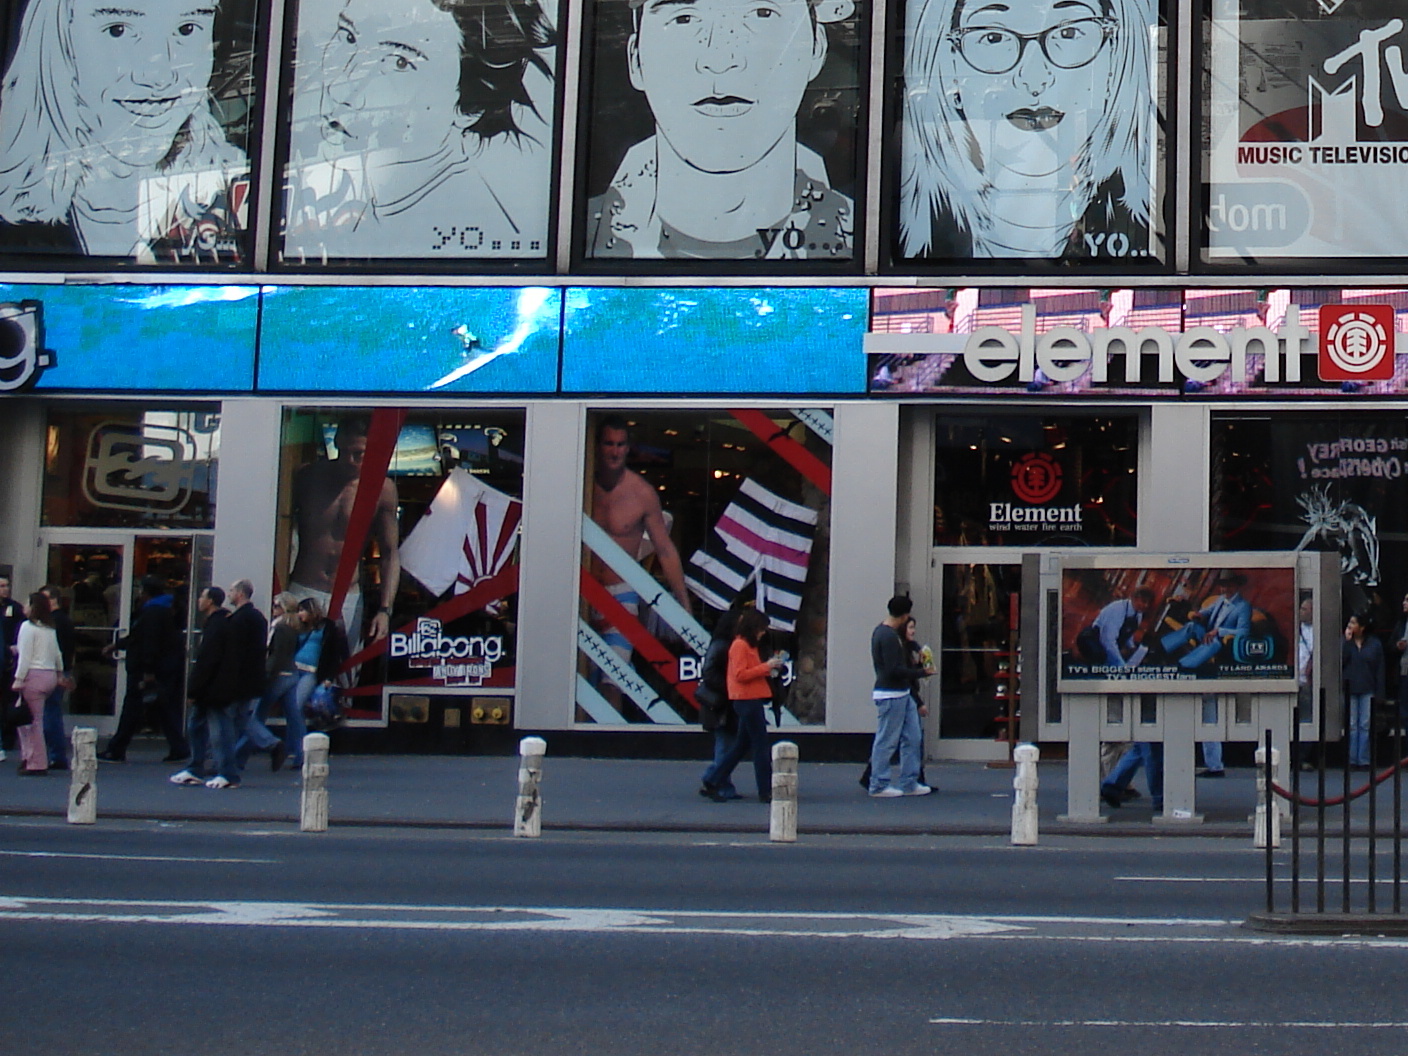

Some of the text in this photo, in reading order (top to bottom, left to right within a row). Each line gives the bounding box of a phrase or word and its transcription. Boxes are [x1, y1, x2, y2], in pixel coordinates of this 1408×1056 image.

[1237, 146, 1303, 164] MUSIC
[962, 303, 1310, 383] element
[989, 502, 1083, 522] Element
[989, 522, 1083, 532] wind water fire earth
